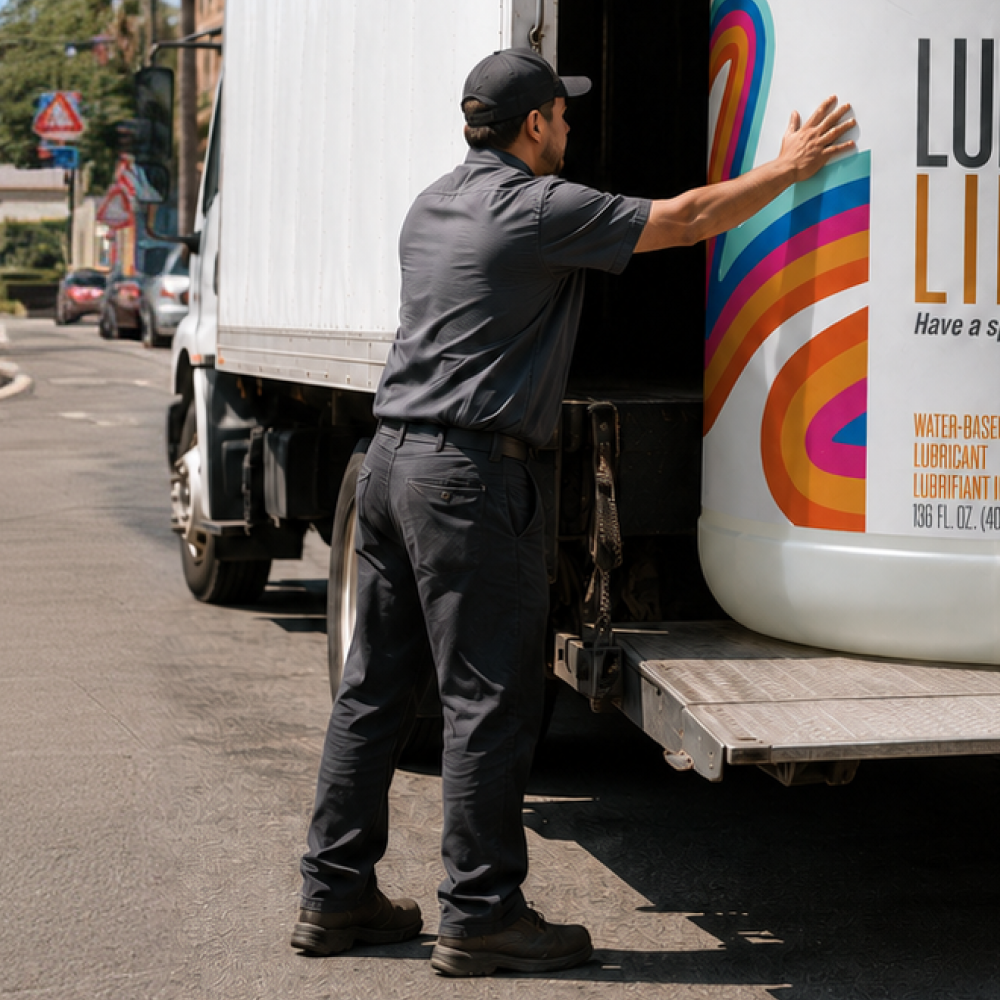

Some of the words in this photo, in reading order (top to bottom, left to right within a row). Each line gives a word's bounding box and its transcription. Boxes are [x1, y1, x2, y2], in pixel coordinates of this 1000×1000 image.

[914, 311, 963, 335] Have
[967, 317, 982, 337] a
[913, 442, 989, 470] LUBRICANT
[913, 473, 991, 501] LUBRIFIANT
[913, 503, 933, 529] 136
[937, 504, 954, 530] FL.
[957, 505, 977, 531] OZ.
